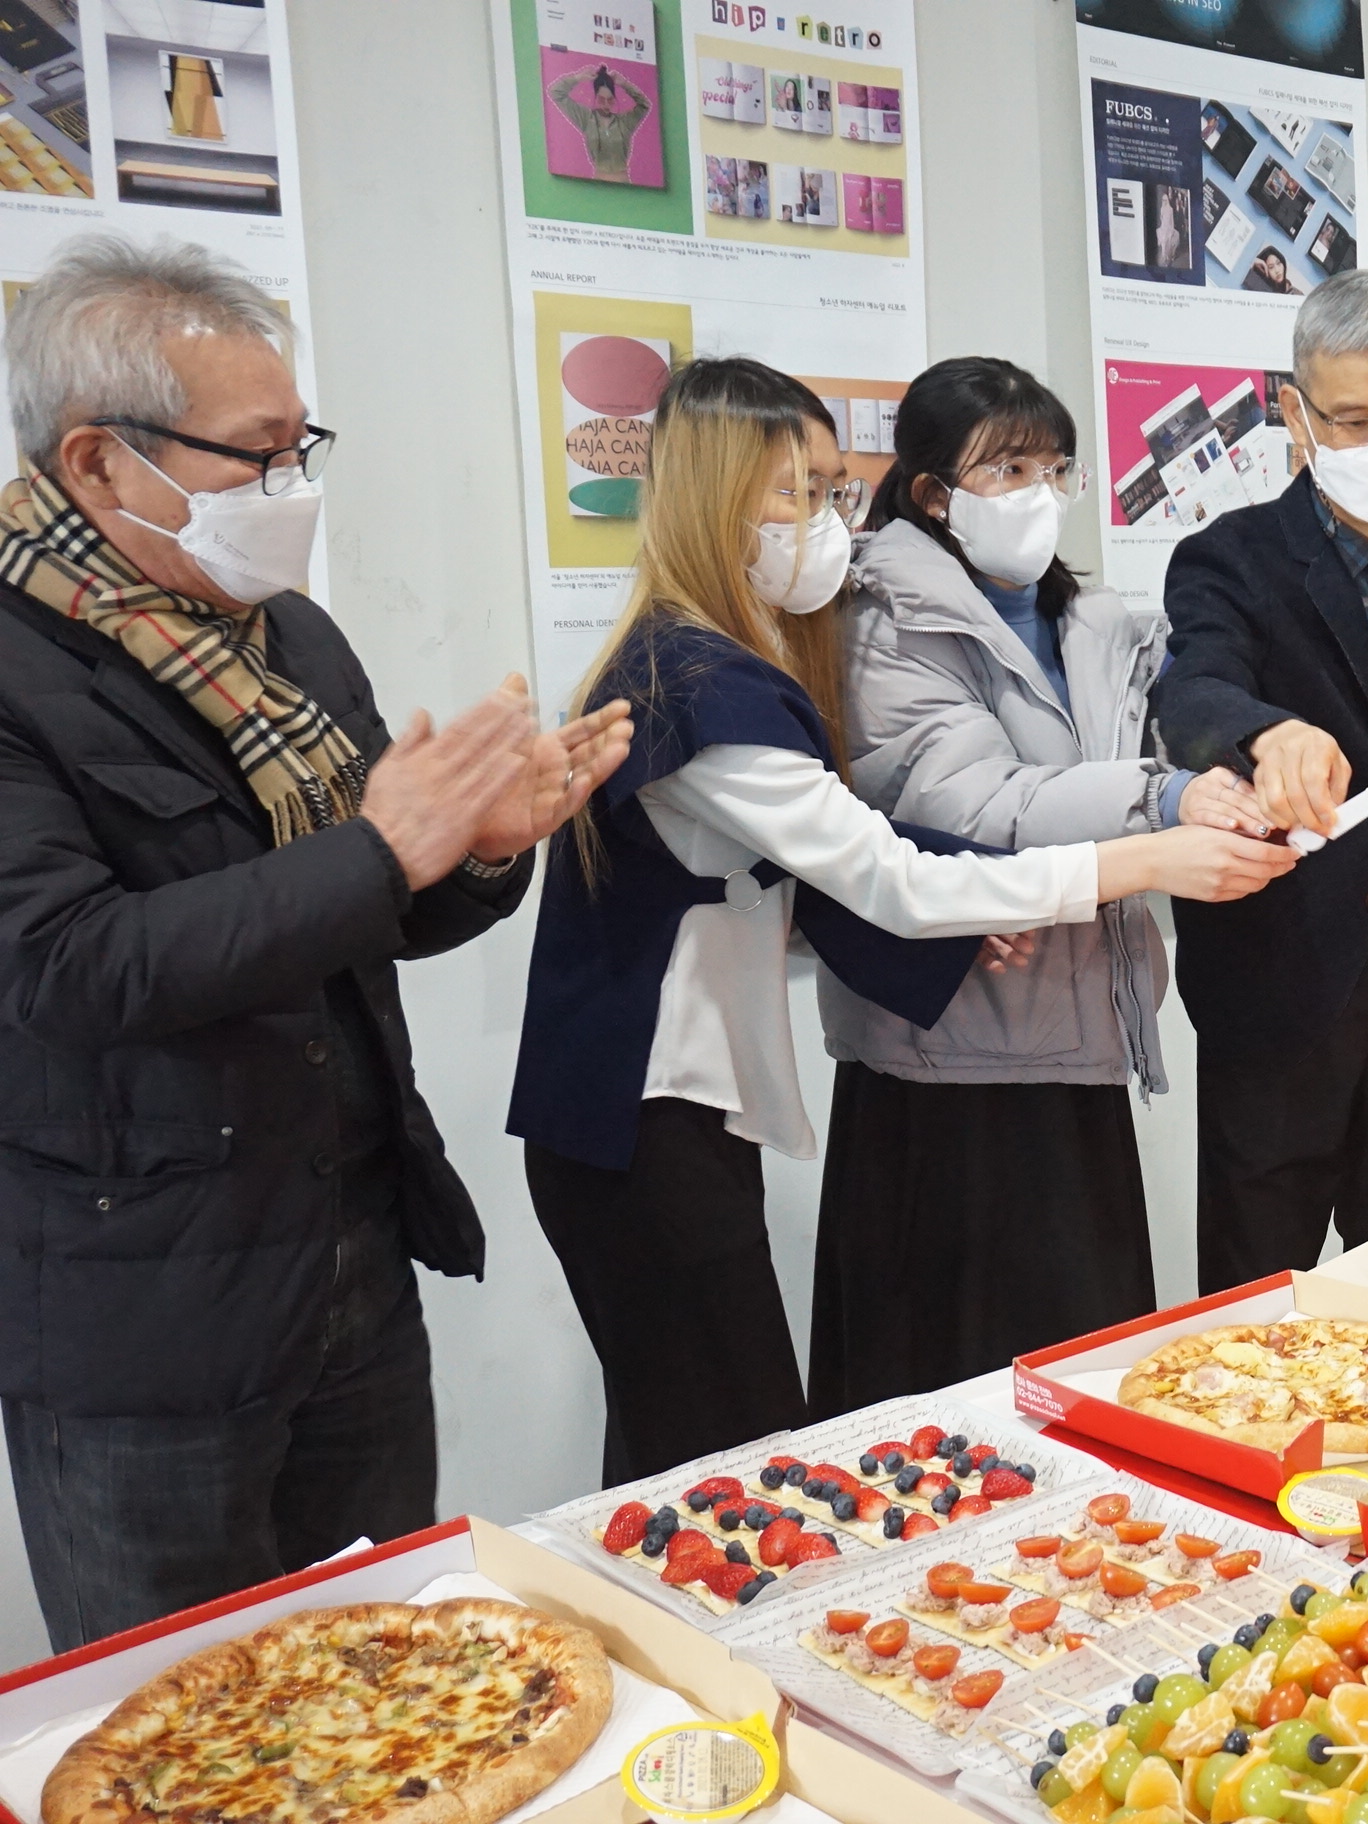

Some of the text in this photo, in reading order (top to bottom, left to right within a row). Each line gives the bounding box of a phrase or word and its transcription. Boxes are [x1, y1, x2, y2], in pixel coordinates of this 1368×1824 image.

[796, 15, 883, 50] retro
[275, 277, 289, 287] UP
[530, 269, 597, 284] ANNUAL REPORT
[566, 438, 606, 457] HAJA
[554, 620, 594, 628] PERSONAL
